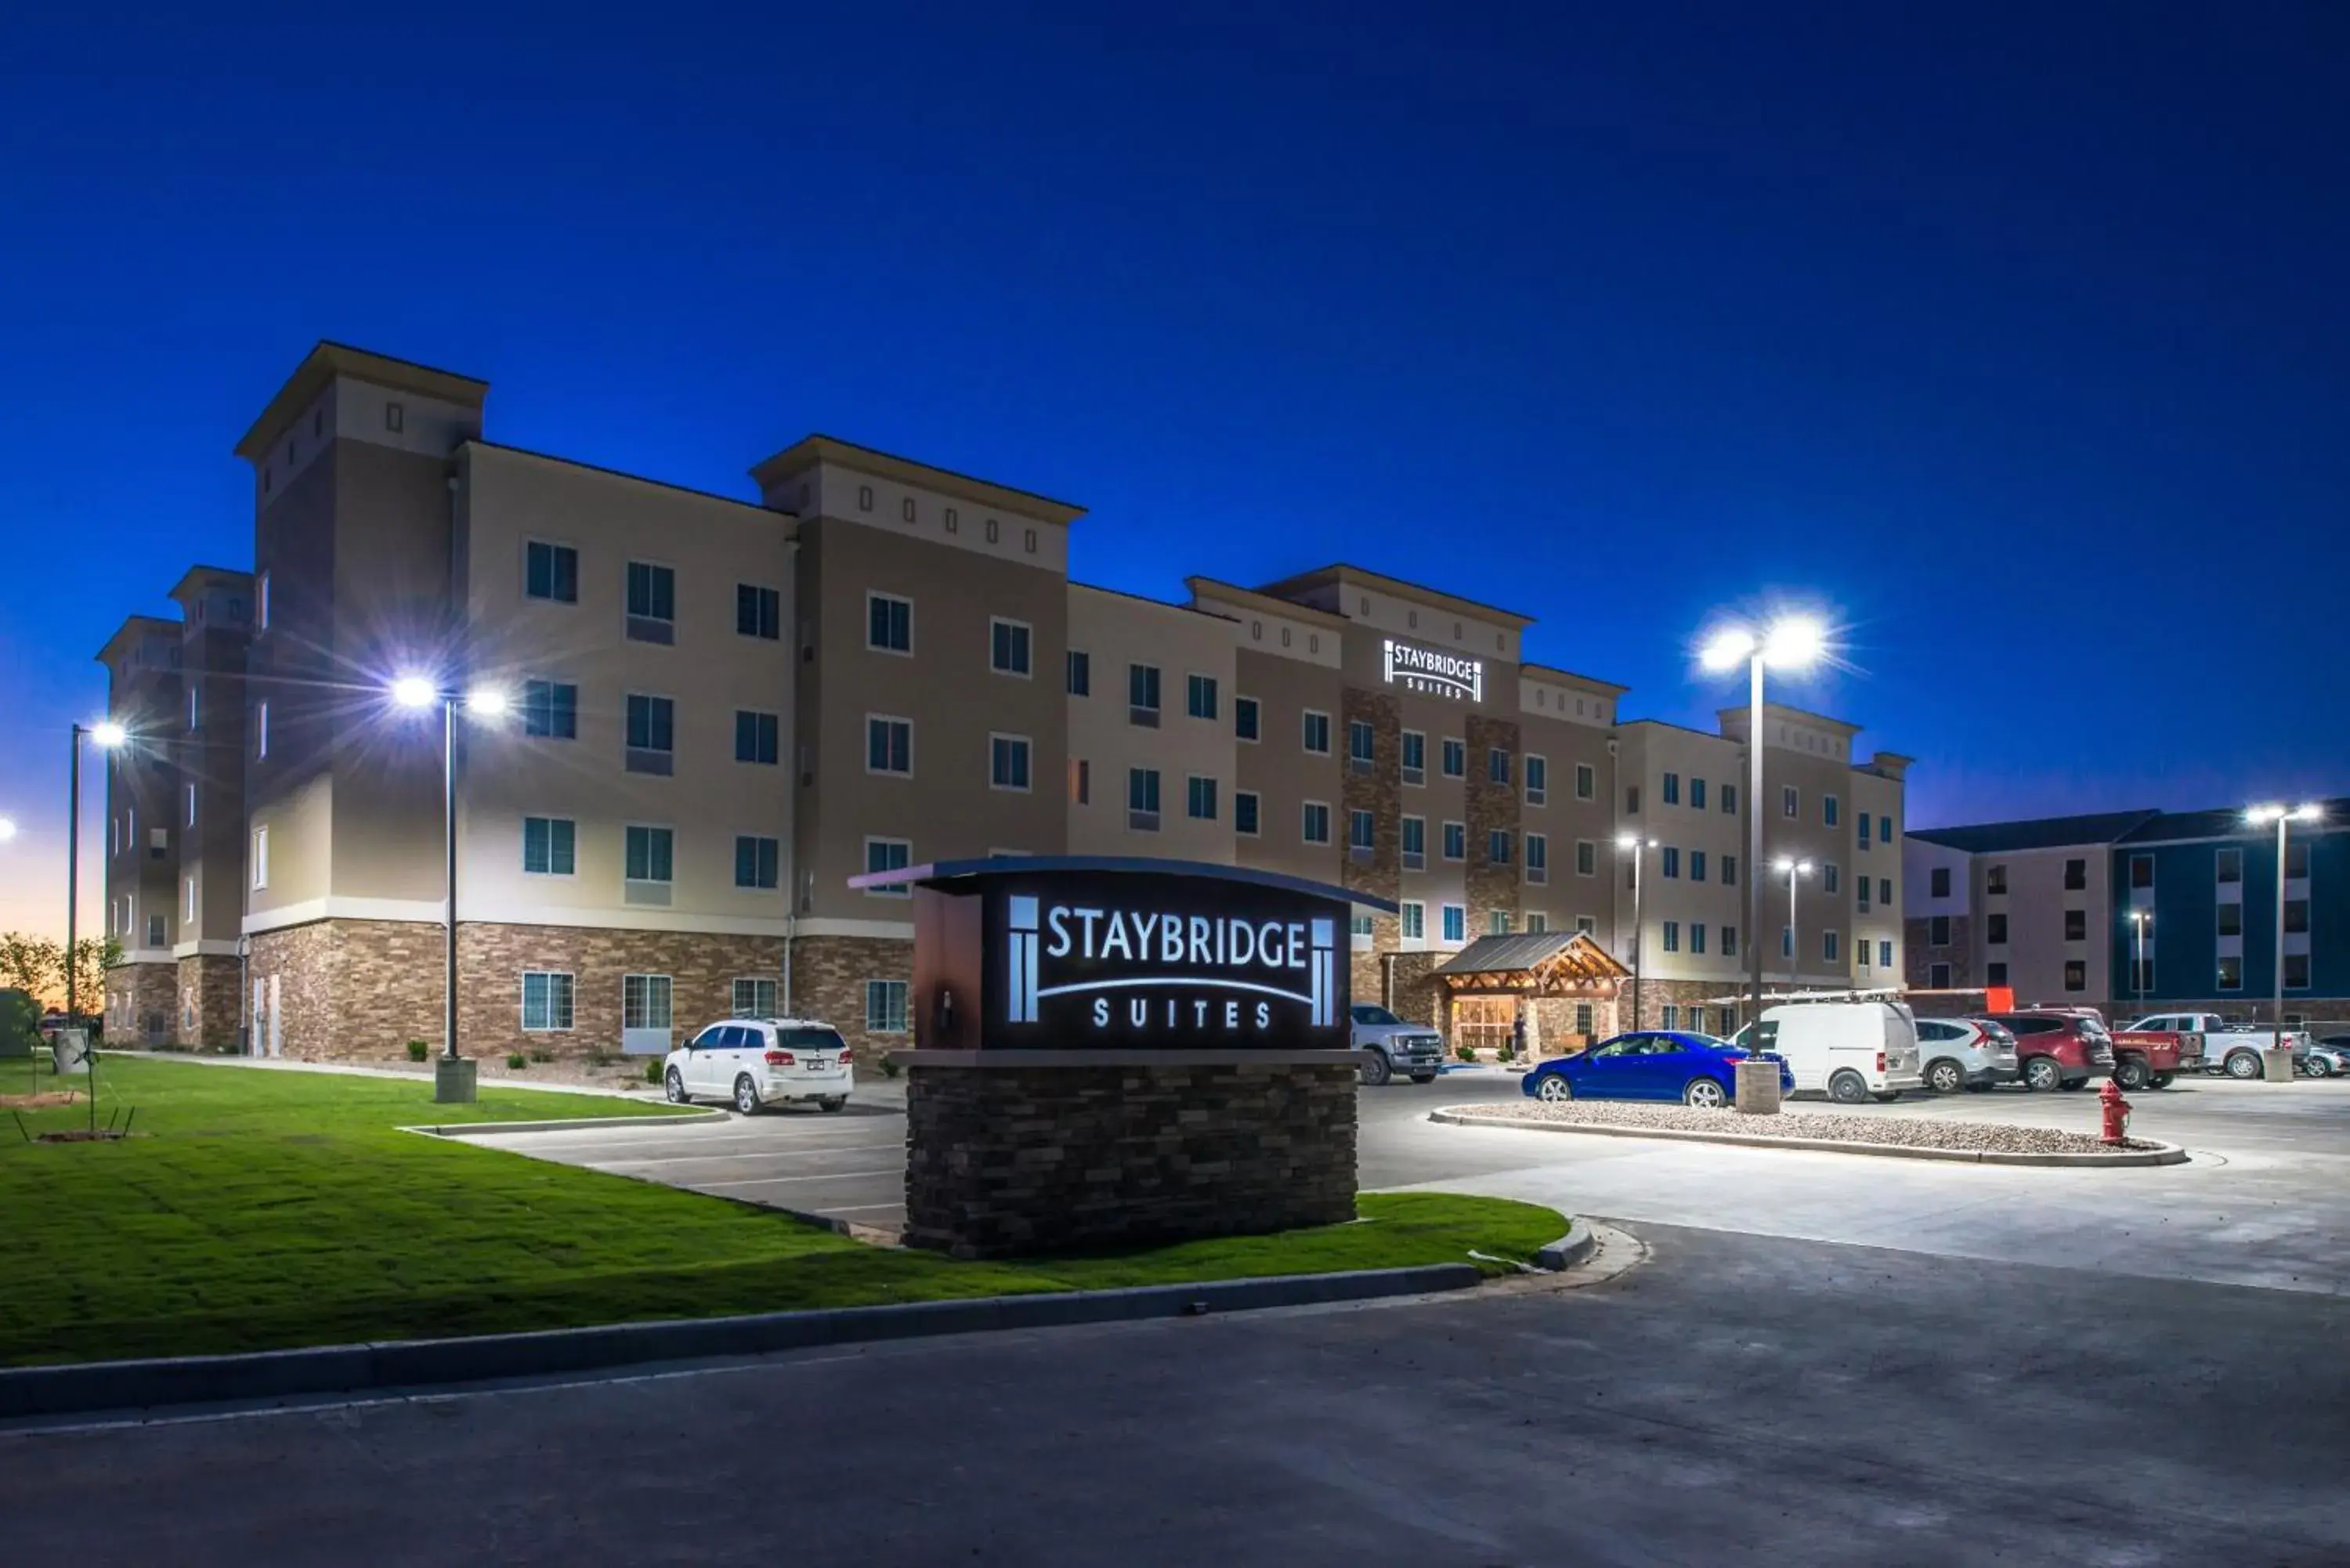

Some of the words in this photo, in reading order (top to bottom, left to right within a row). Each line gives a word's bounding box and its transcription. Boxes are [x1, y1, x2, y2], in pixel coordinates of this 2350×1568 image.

[1395, 645, 1472, 680] STAYBRIDGE
[1407, 677, 1461, 699] SUITES
[1047, 905, 1307, 968] STAYBRIDGE
[1093, 999, 1271, 1028] SUITES
